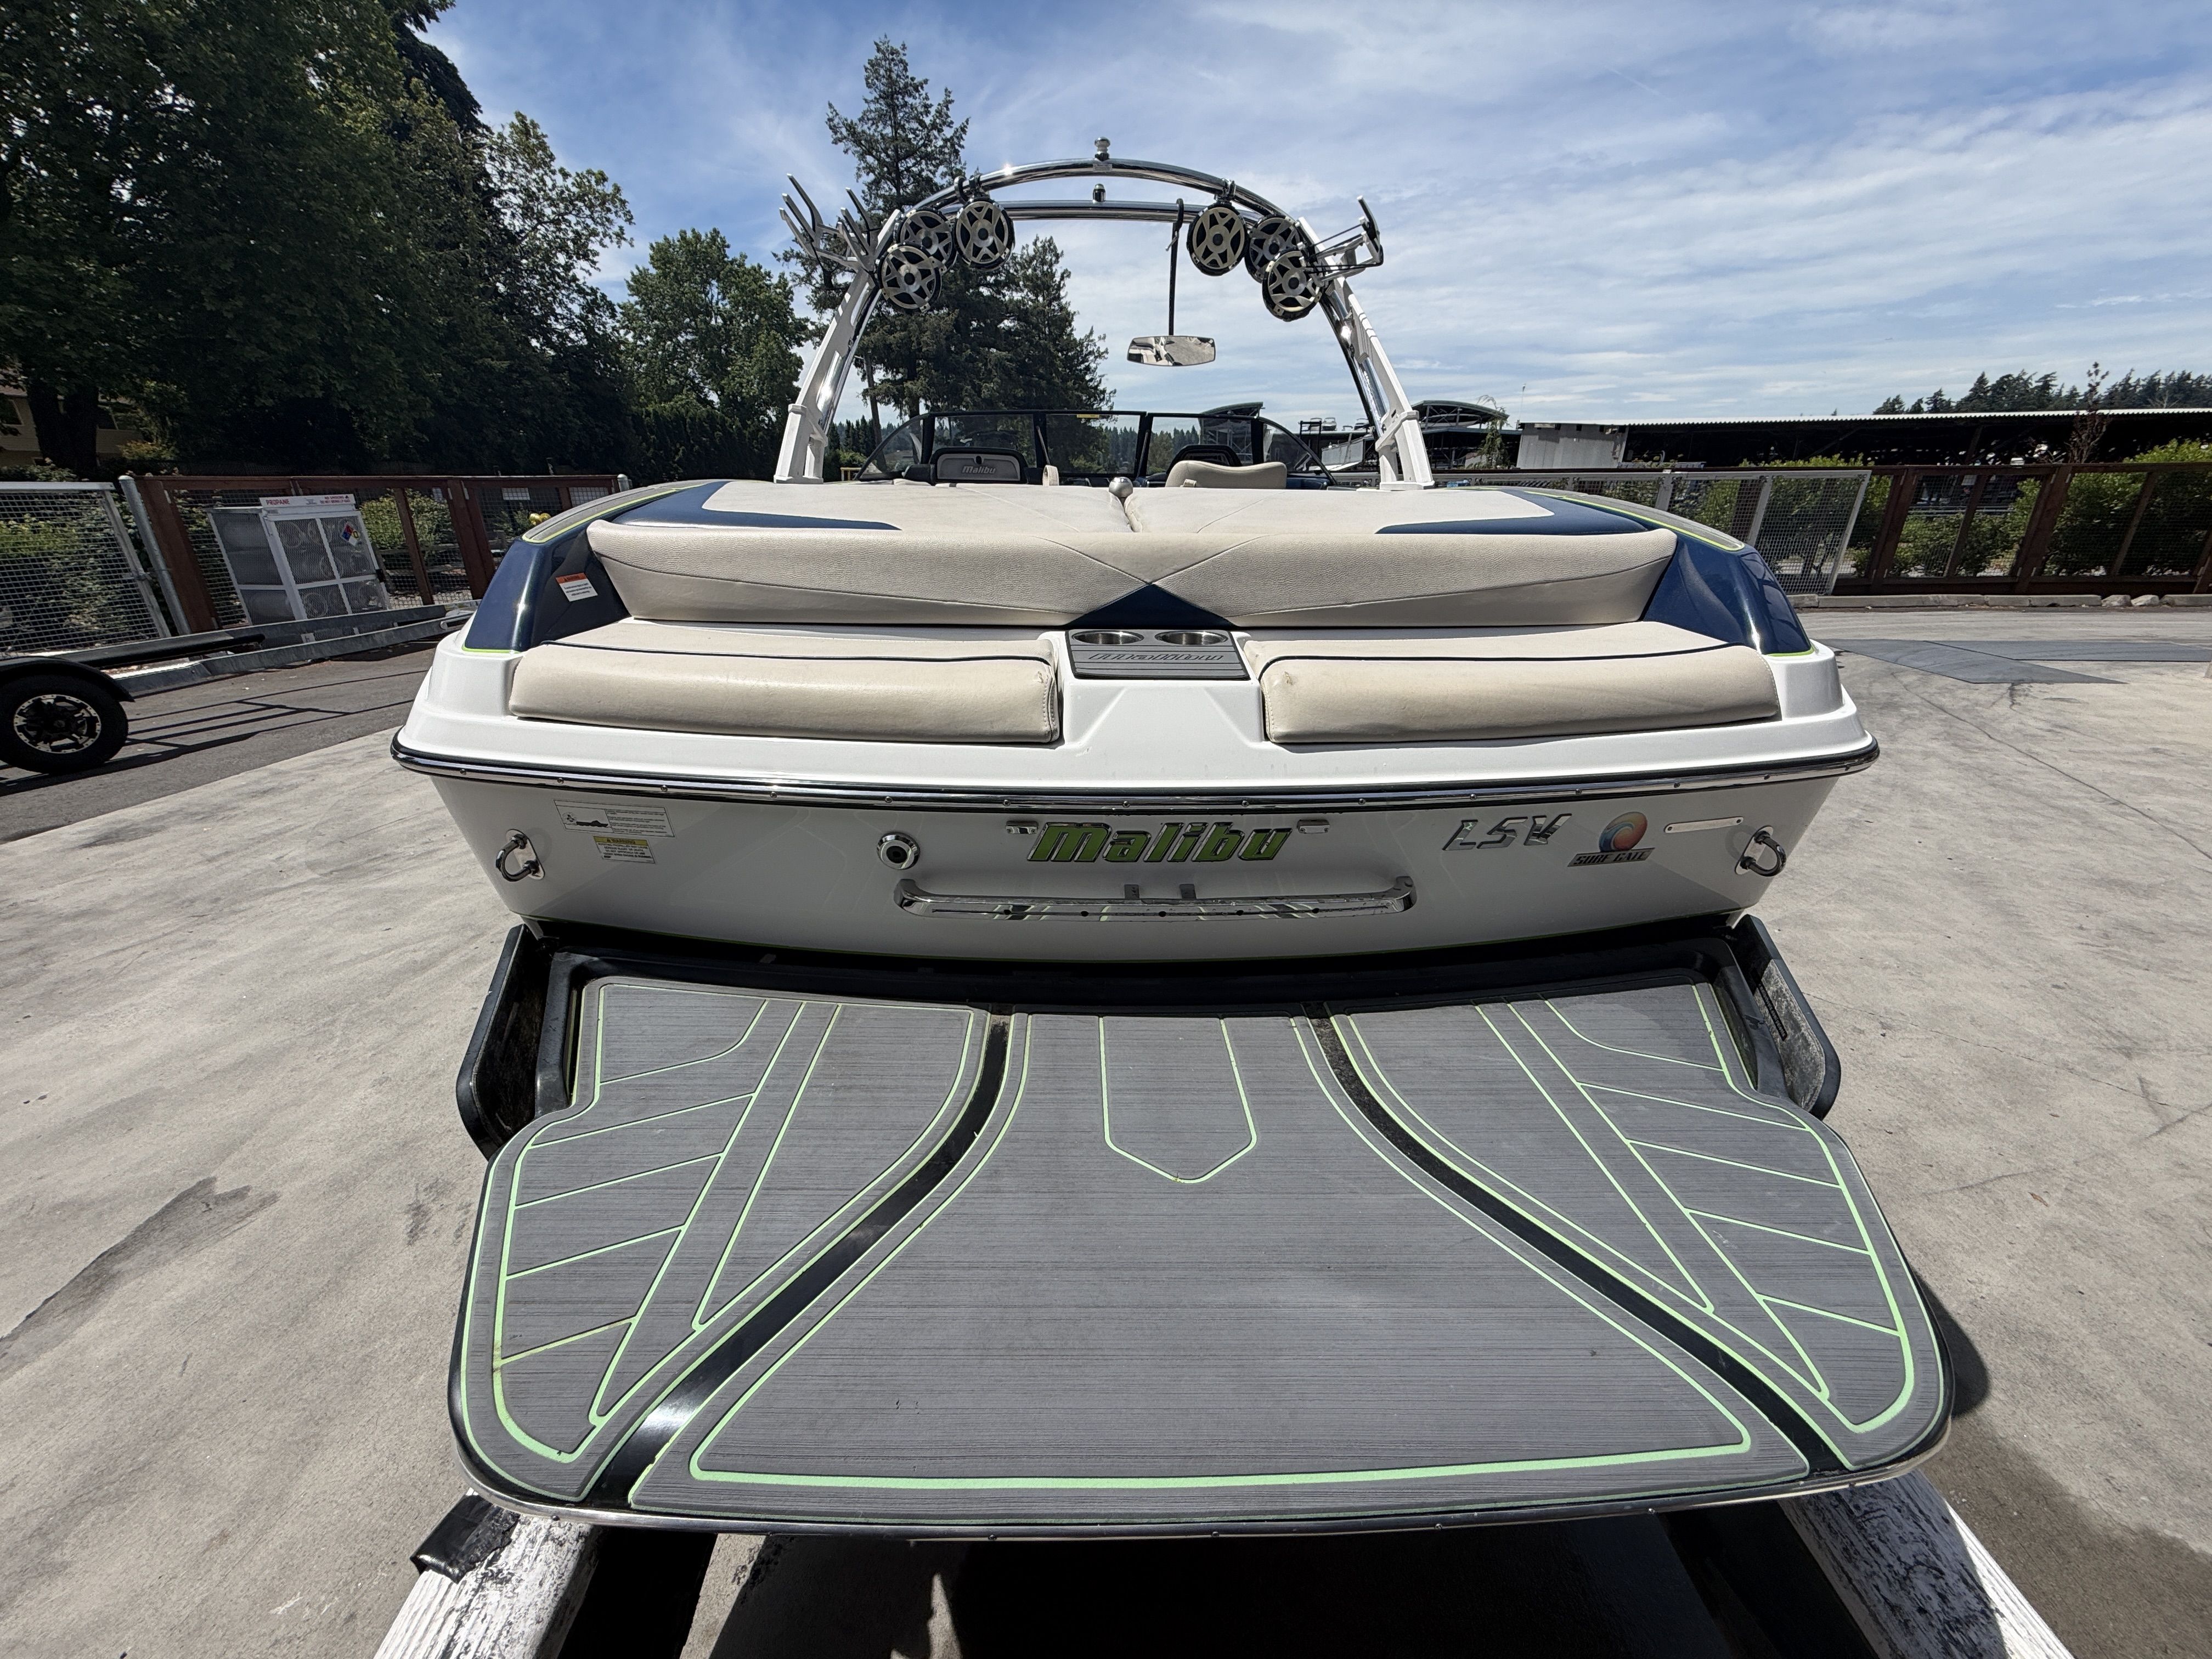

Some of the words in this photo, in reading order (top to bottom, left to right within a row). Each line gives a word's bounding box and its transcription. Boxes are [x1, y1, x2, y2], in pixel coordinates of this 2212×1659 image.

[962, 465, 996, 474] Malibu
[1027, 822, 1293, 862] Malibu
[1442, 813, 1572, 851] LSV
[1573, 854, 1611, 865] SURF
[1613, 851, 1648, 862] GATE
